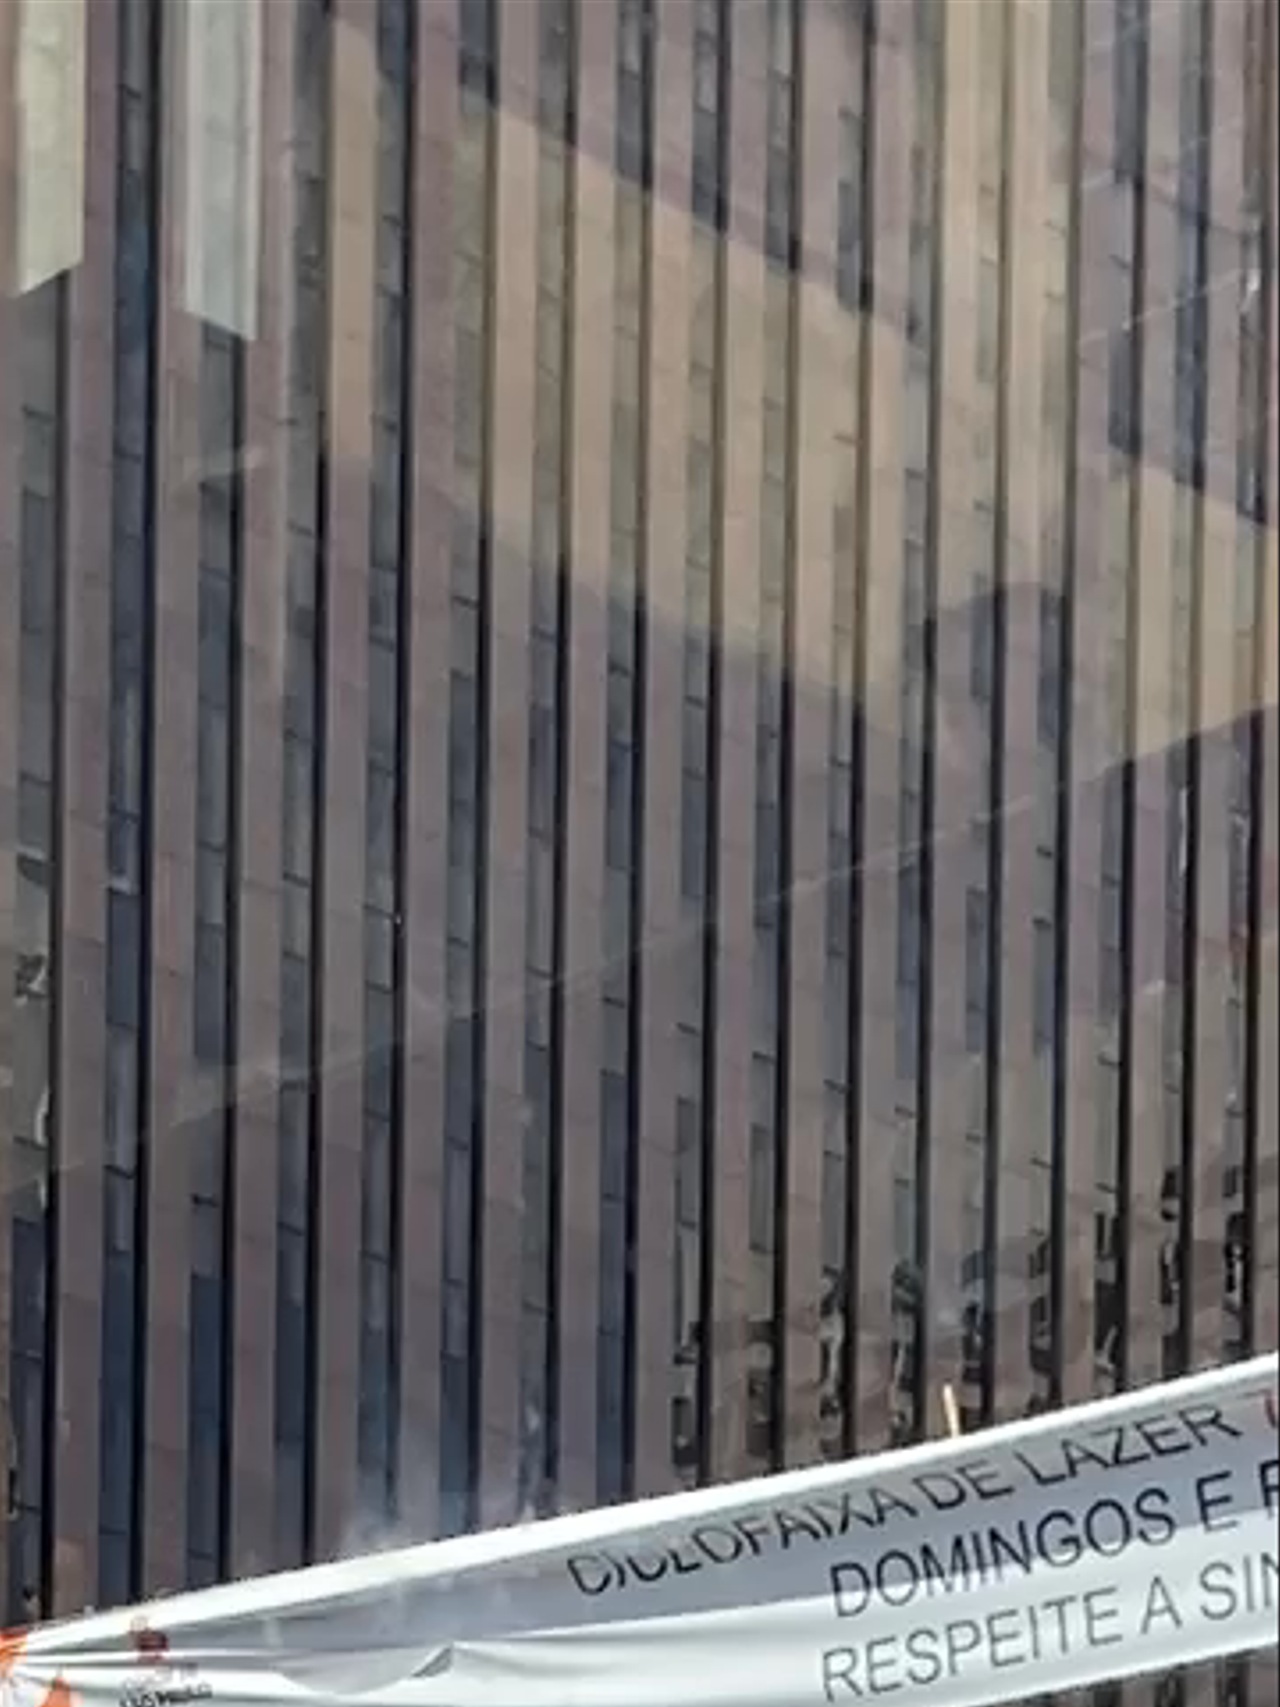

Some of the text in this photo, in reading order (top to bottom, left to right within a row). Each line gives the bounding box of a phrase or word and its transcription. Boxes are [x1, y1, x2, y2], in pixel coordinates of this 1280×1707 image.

[912, 1458, 1016, 1511] DE
[1013, 1402, 1244, 1486] LAZER
[830, 1486, 1177, 1618] DOMINGOS
[1195, 1470, 1238, 1533] E
[823, 1586, 1123, 1702] RESPEITE
[1140, 1575, 1183, 1635] A
